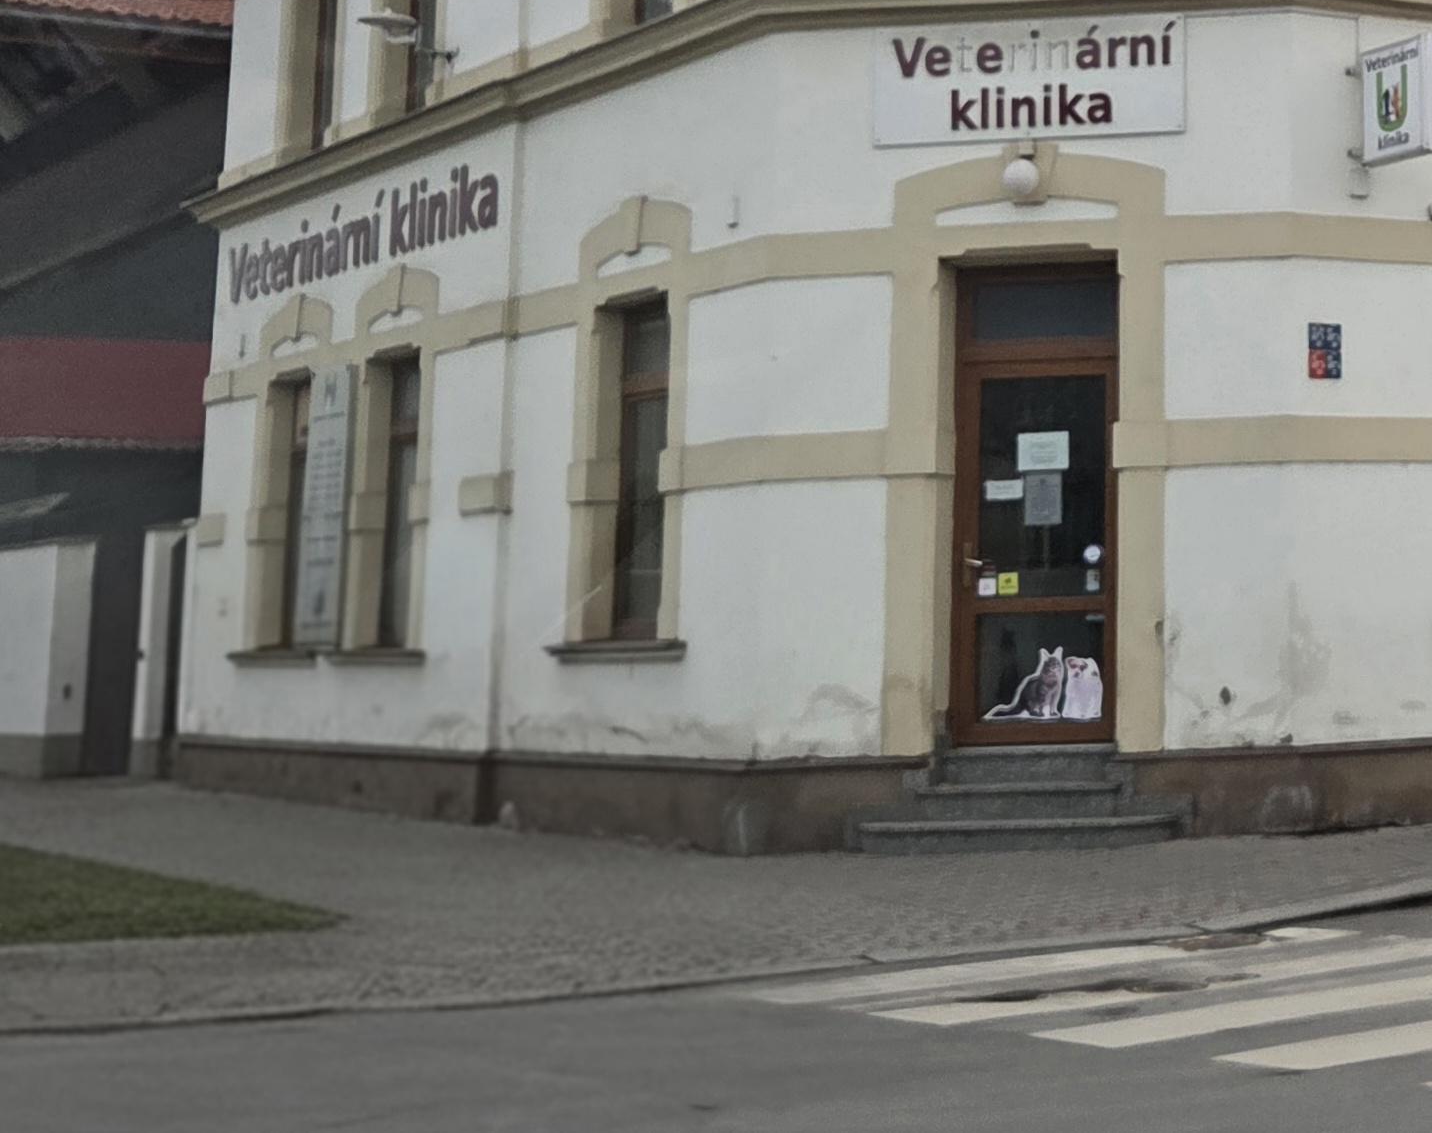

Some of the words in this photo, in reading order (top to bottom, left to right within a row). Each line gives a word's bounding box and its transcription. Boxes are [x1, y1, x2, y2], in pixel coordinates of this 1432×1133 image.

[892, 20, 1176, 79] Veterinární
[1364, 44, 1419, 73] Veterinární
[950, 83, 1113, 131] klinika
[228, 188, 386, 305] Veterinární
[388, 163, 499, 258] klinika
